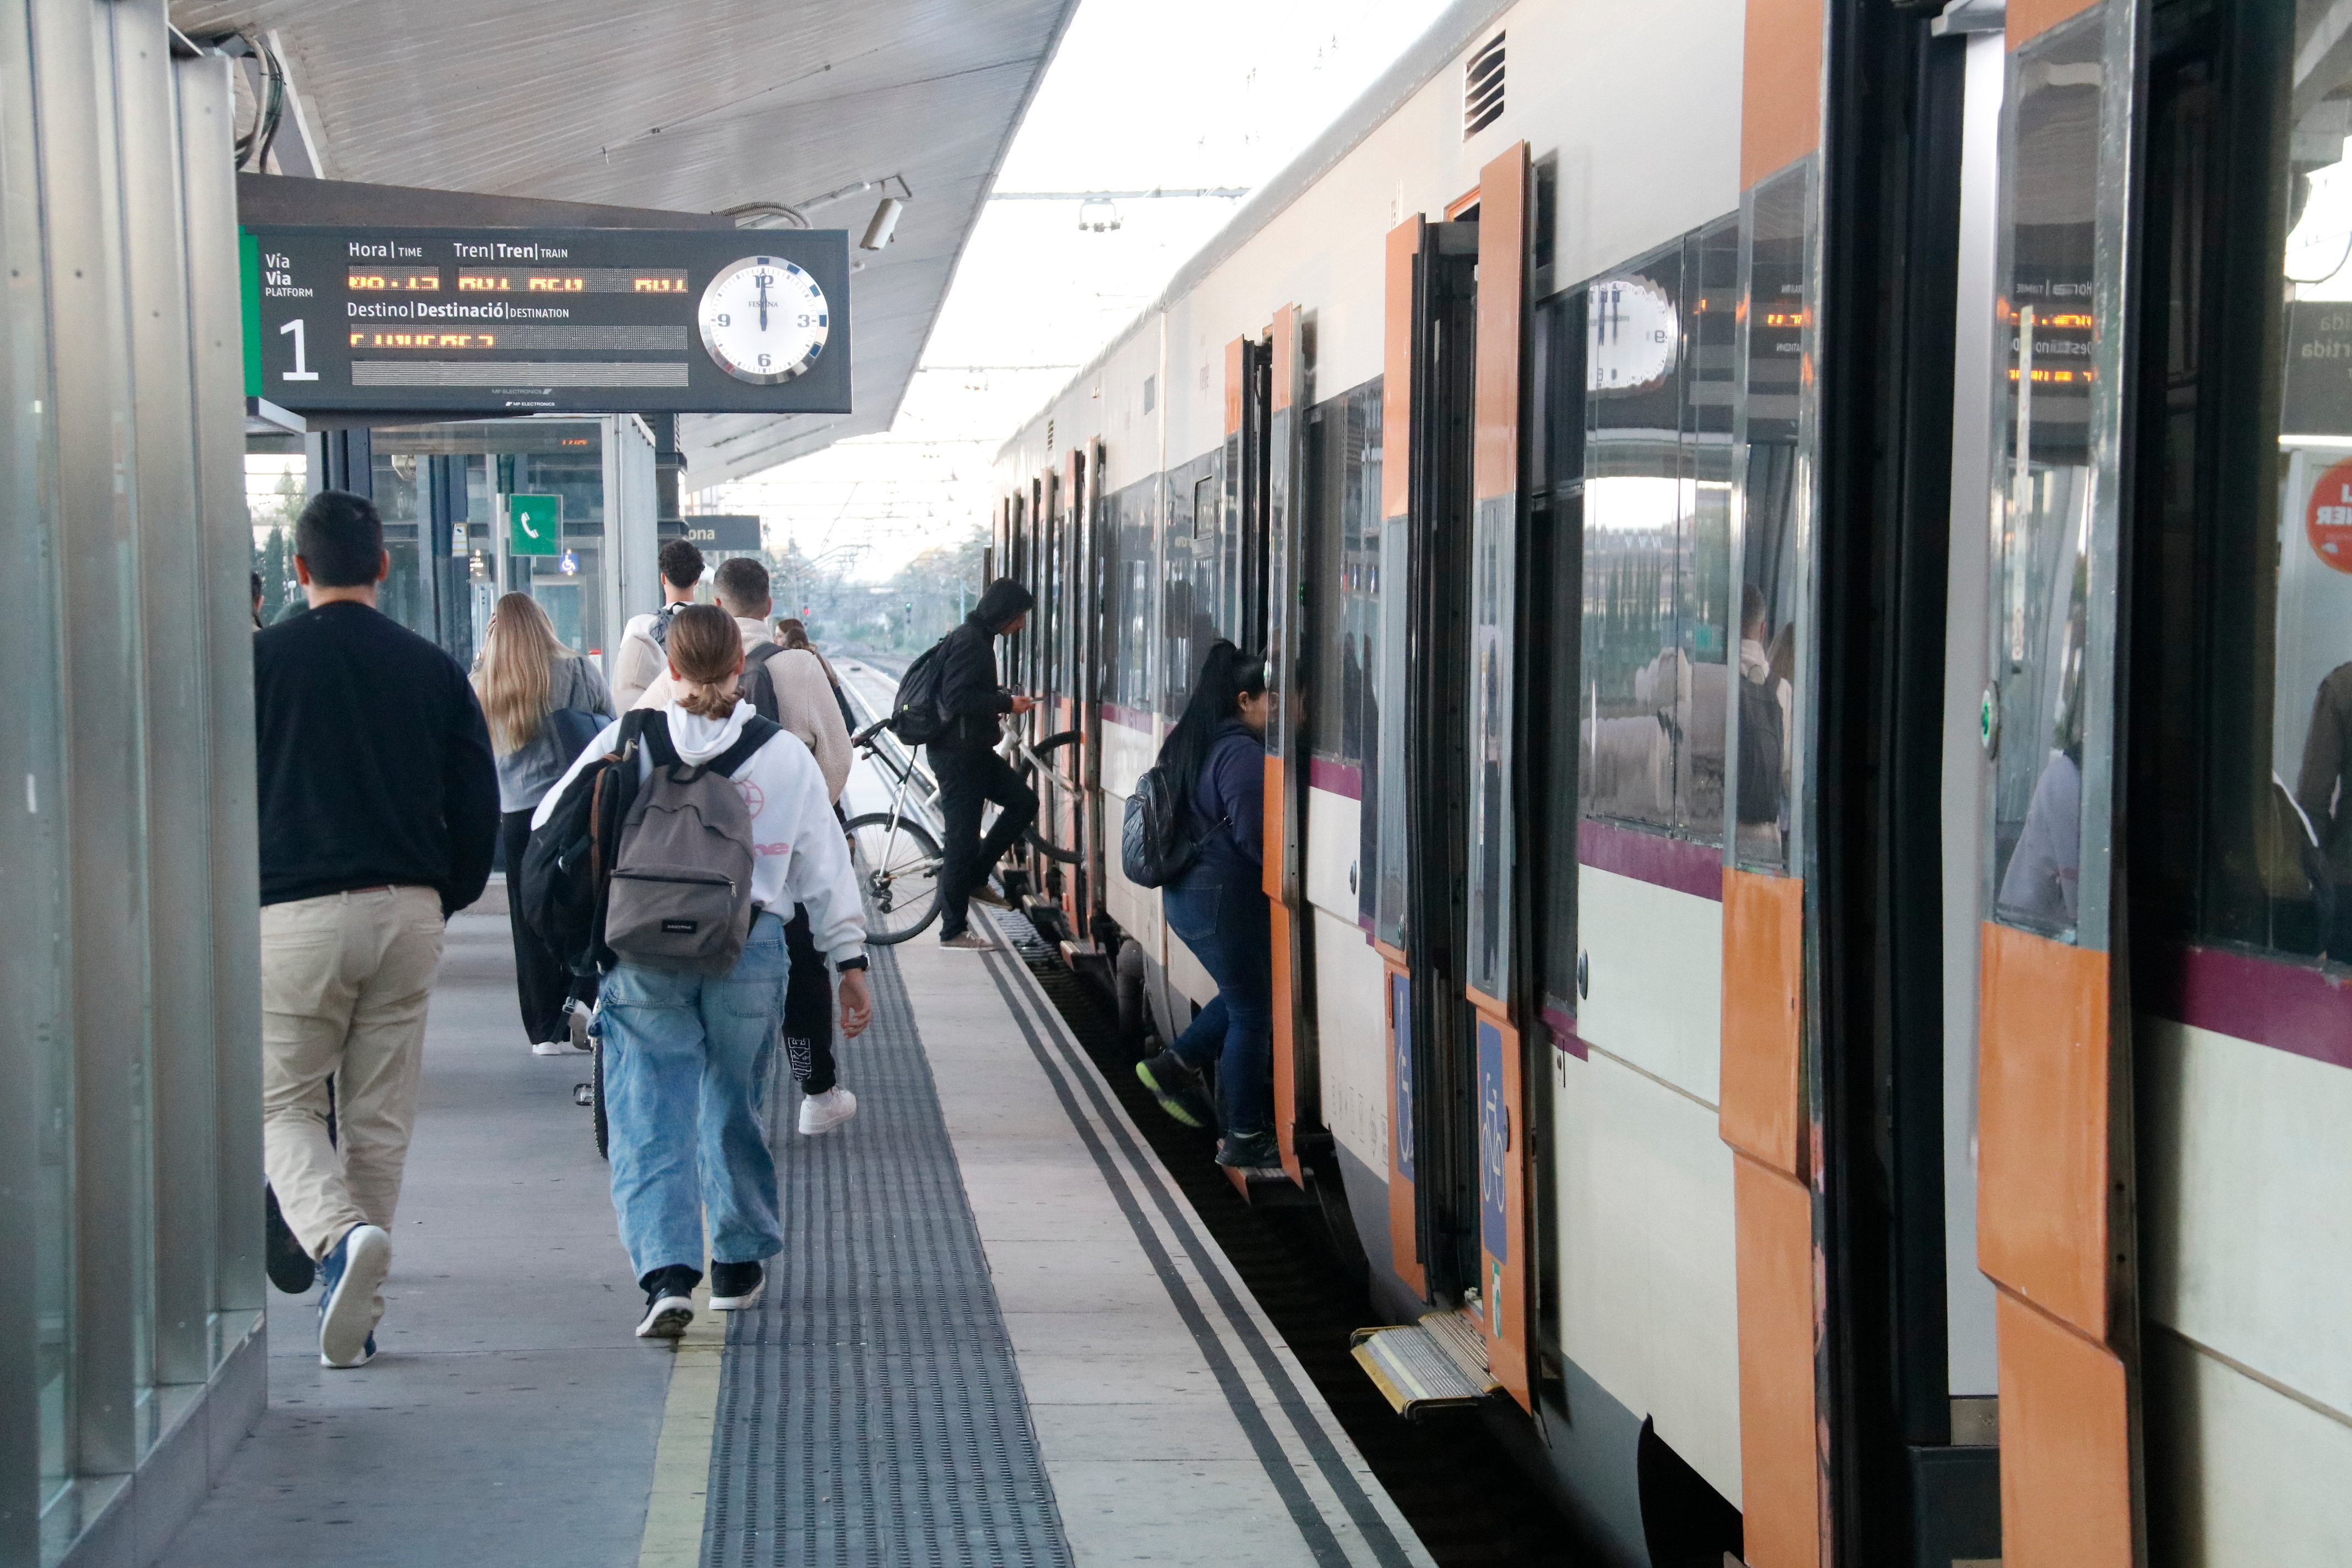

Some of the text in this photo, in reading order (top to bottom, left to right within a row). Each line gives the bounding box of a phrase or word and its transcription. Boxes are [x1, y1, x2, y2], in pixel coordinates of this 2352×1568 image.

[349, 242, 422, 257] Hora TIME
[453, 243, 568, 258] Tren Tren TRAIN
[265, 253, 290, 269] Vía
[265, 270, 291, 286] Via
[265, 287, 313, 297] PLATFORM
[347, 302, 569, 318] Destino Destinació DESTINATION
[717, 313, 731, 328] 9
[797, 314, 810, 328] 3
[280, 319, 319, 381] 1
[758, 353, 771, 367] 6
